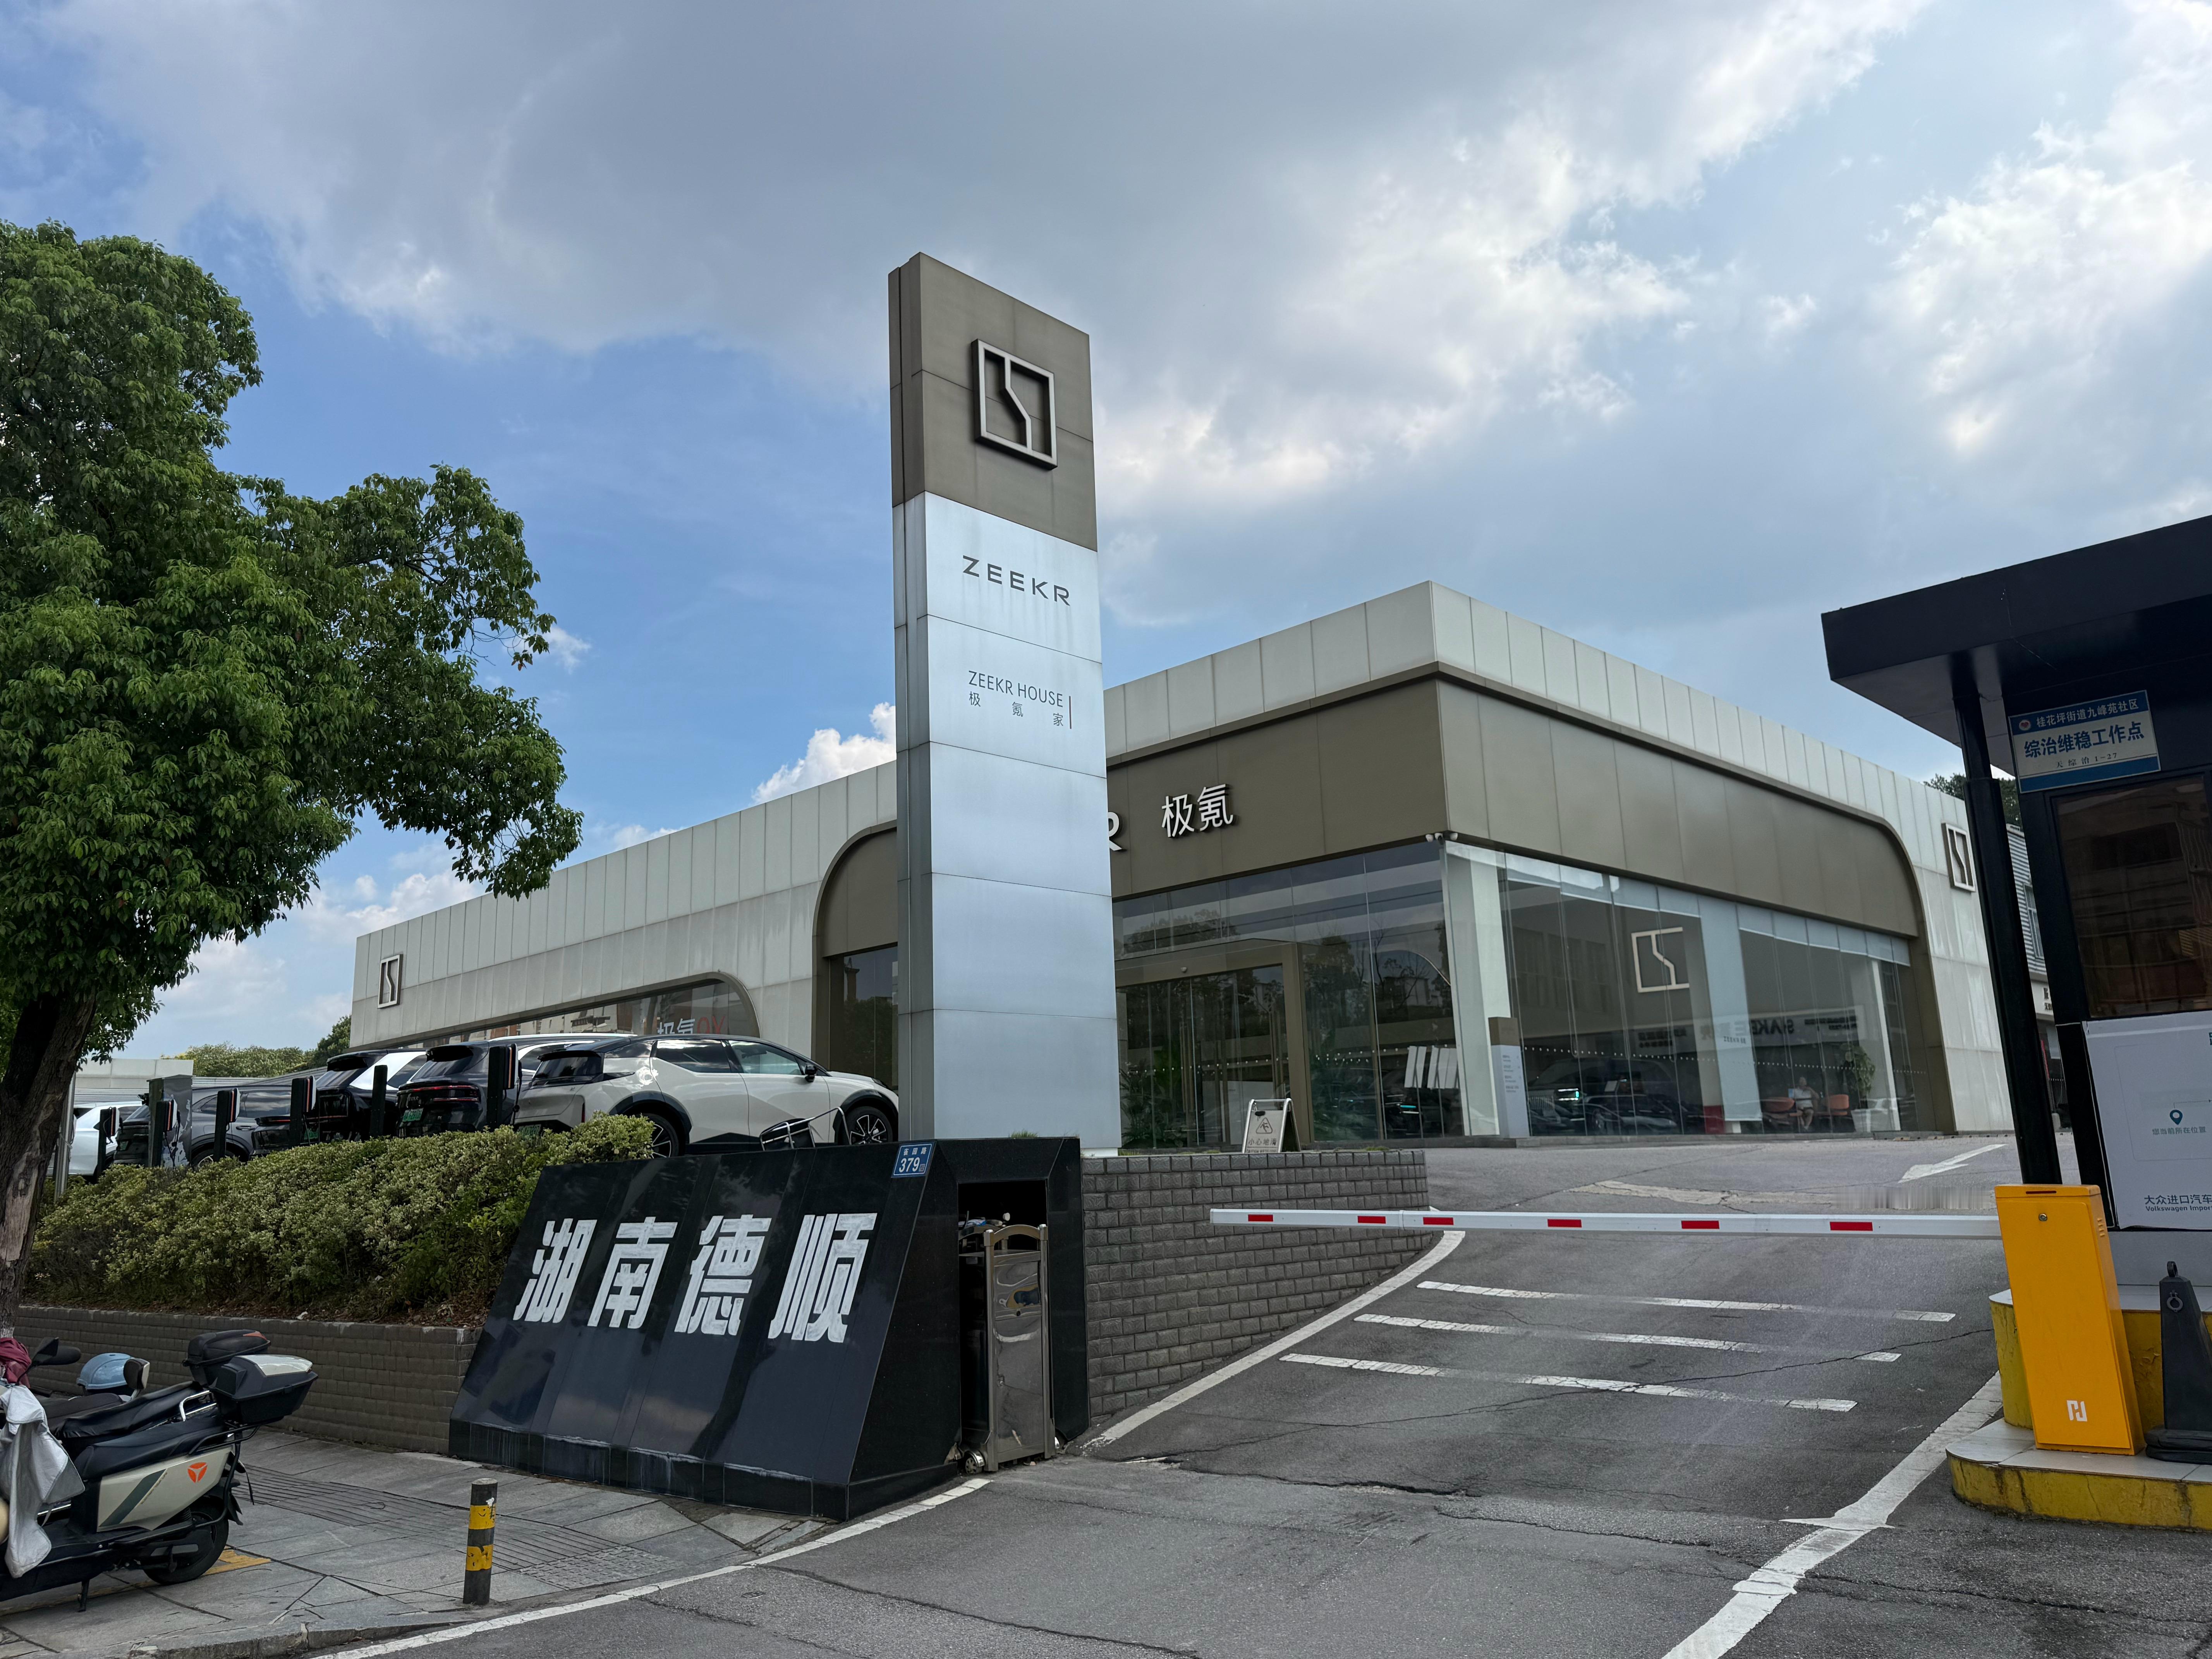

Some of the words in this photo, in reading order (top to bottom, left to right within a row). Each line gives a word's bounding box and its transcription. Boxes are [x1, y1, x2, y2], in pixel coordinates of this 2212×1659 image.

[962, 555, 1070, 606] ZEEKR
[968, 670, 1013, 696] ZEEKR
[1018, 682, 1063, 708] HOUSE
[969, 691, 1064, 727] 极氪家
[2036, 698, 2139, 728] 桂花坪街道九峰苑社区
[2024, 721, 2145, 758] 综治维稳工作点
[1161, 783, 1234, 838] 极氪
[898, 1157, 921, 1173] 379
[2144, 1194, 2212, 1205] 大众进口汽车
[513, 1212, 878, 1343] 湖南德顺
